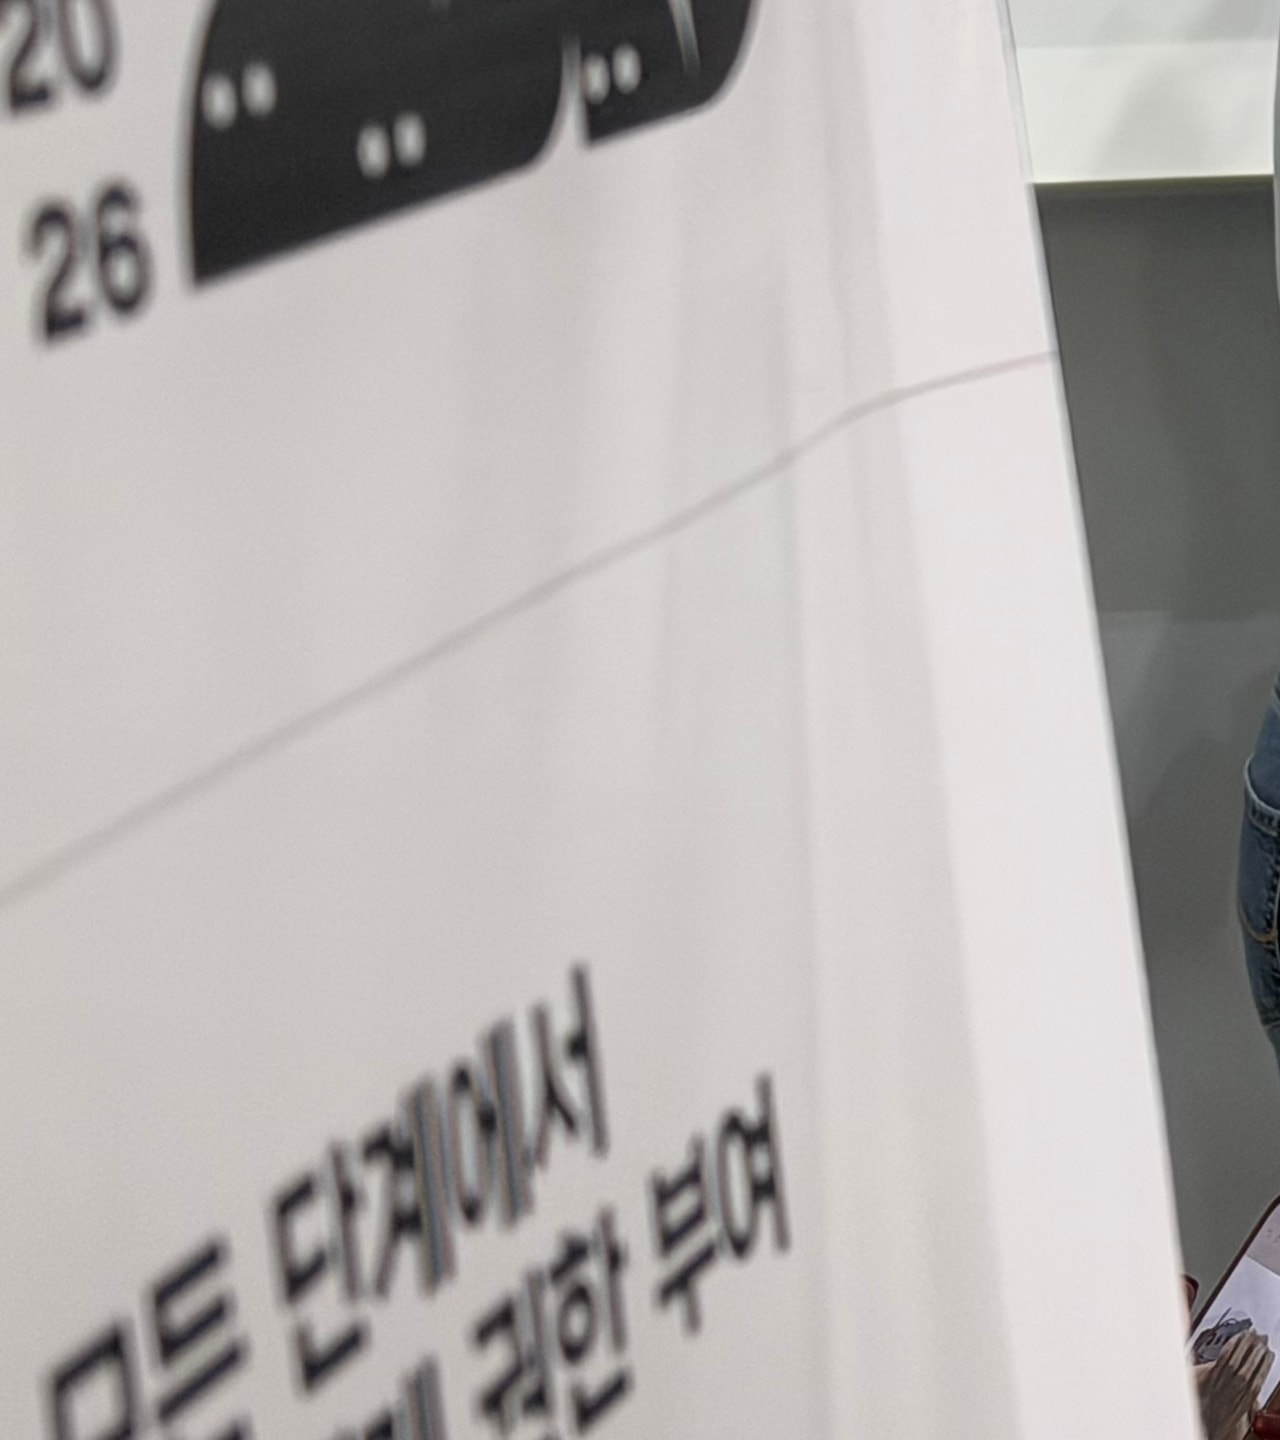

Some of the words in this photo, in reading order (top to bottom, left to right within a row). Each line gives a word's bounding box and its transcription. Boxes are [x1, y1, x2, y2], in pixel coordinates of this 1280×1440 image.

[25, 178, 155, 348] 26
[268, 960, 612, 1402] 단계에서
[648, 1072, 794, 1336] 부여
